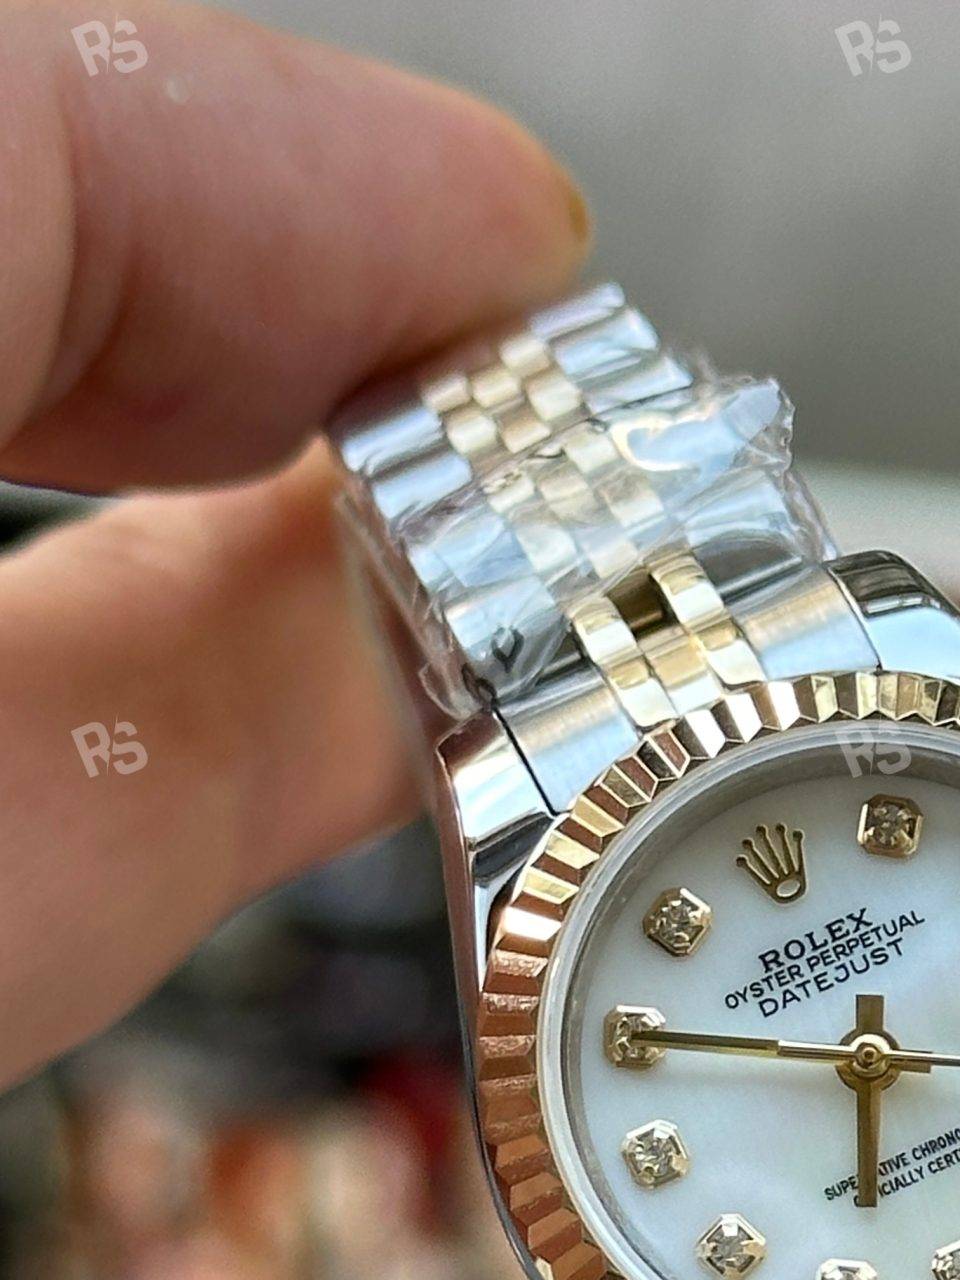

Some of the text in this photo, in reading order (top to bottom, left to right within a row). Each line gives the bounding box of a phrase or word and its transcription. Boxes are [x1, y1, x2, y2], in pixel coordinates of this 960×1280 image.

[725, 910, 925, 1009] OYSTER PERPETUAL
[758, 908, 873, 973] ROLEX
[758, 938, 904, 1018] DATEJUST
[824, 1152, 911, 1201] SUPETIVE
[853, 1165, 925, 1207] ICIALLY
